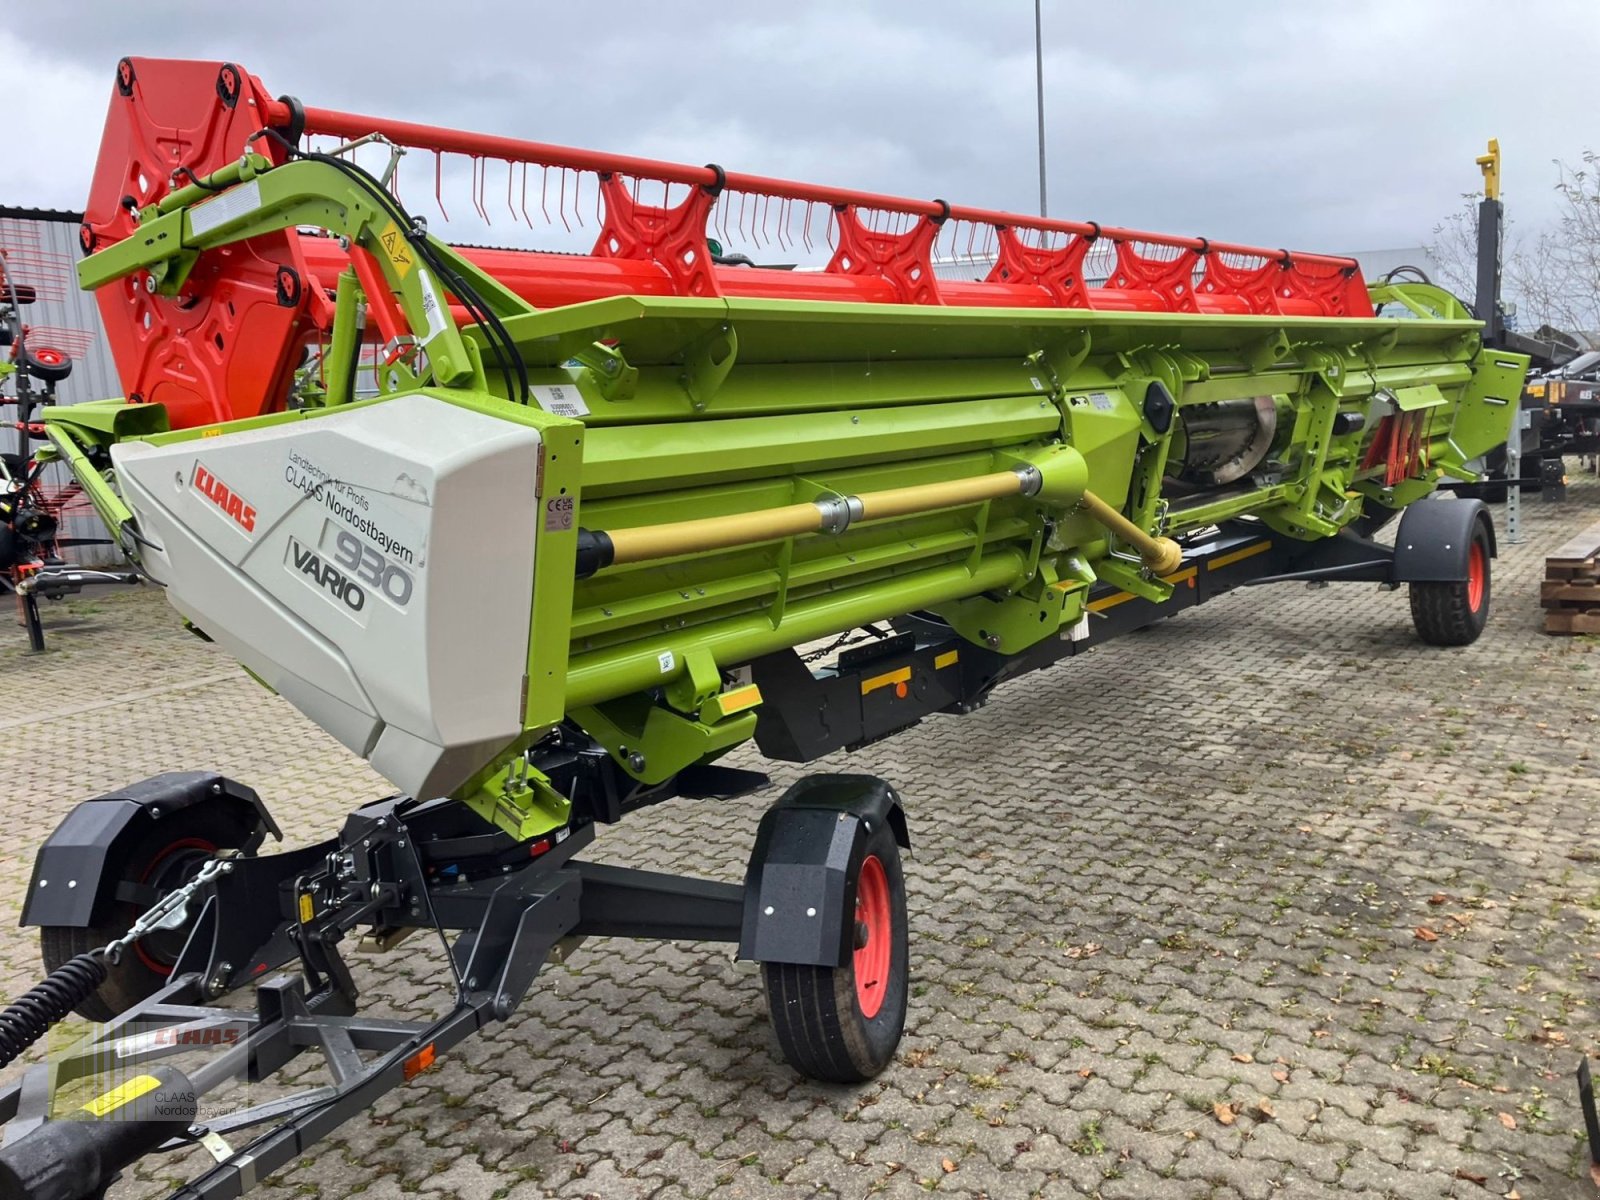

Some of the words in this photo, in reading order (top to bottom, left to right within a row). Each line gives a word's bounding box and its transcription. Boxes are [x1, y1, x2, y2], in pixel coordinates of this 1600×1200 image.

[194, 466, 257, 533] CLAAS
[285, 465, 324, 502] CLAAS
[325, 491, 413, 564] Nordostbayern
[288, 448, 333, 486] Landtechnik
[346, 486, 370, 511] Profis
[293, 541, 365, 612] VARIO
[334, 530, 413, 606] 930
